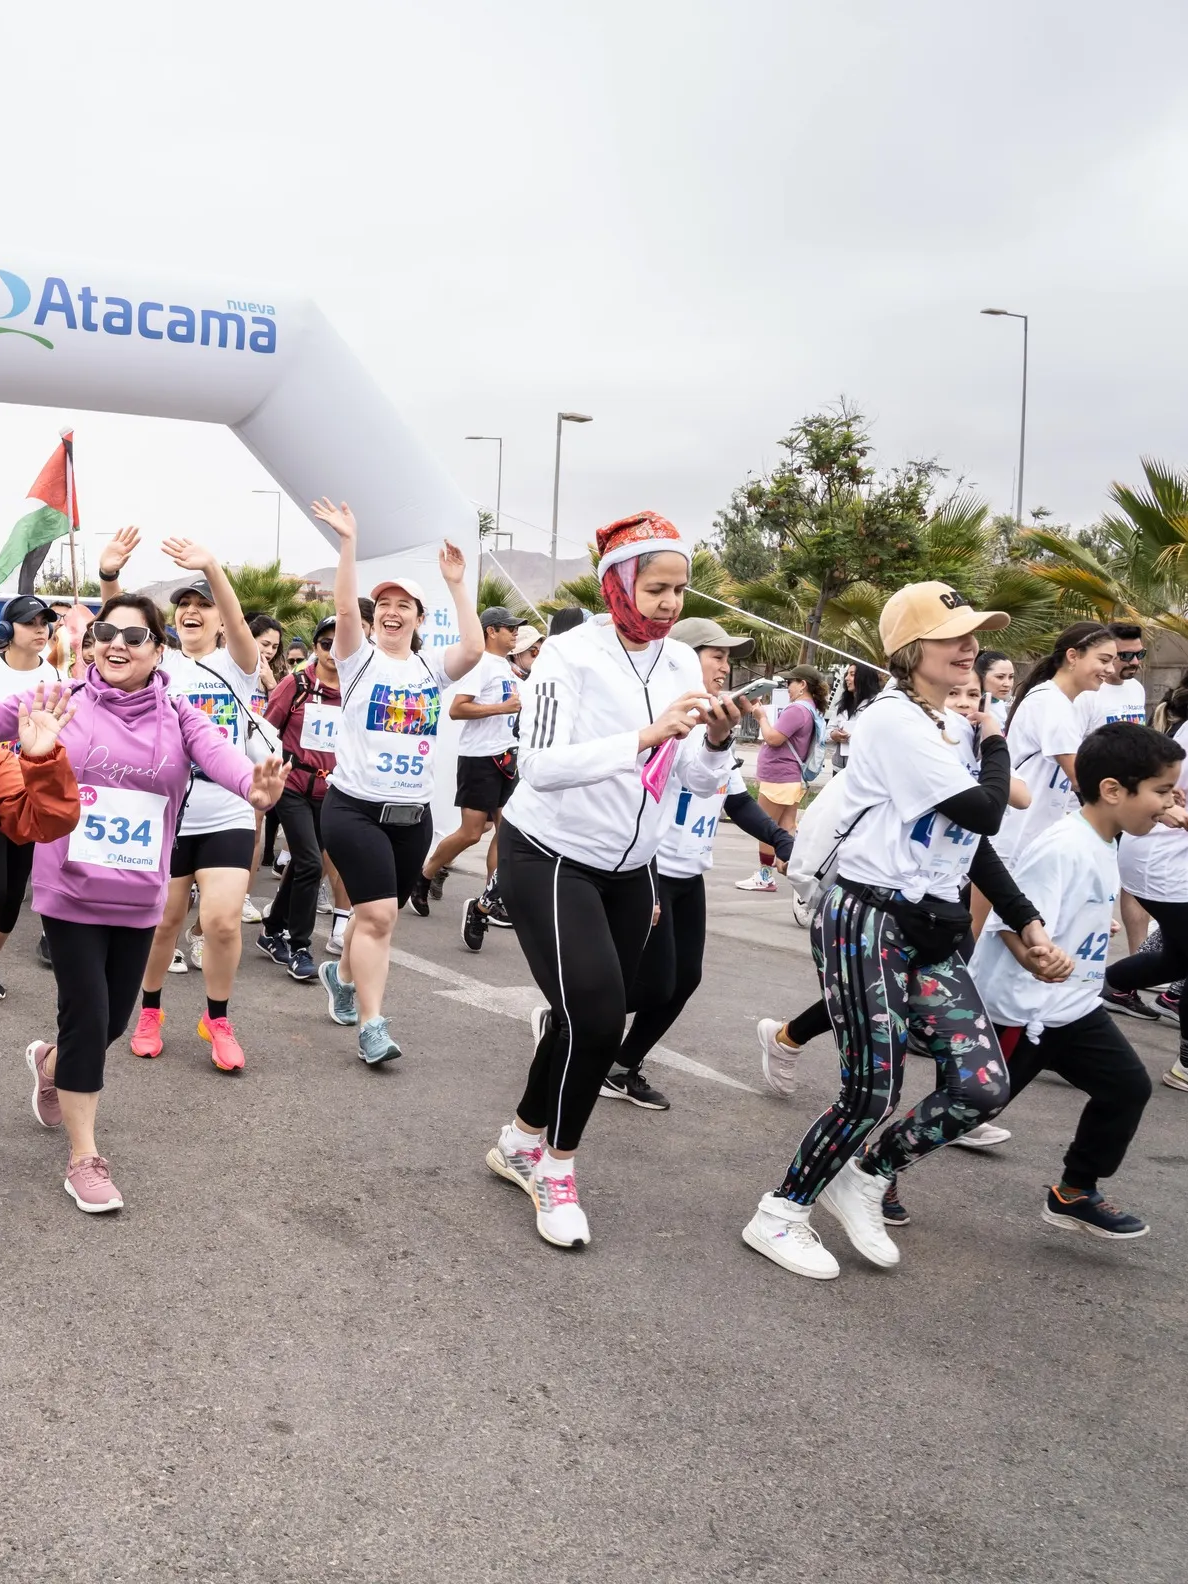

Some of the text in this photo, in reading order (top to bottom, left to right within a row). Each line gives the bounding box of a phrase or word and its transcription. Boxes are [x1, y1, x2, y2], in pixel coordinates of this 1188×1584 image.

[34, 277, 276, 353] Atacama
[227, 300, 275, 315] nueva
[434, 608, 451, 628] ti,
[198, 681, 228, 689] Ataca
[311, 720, 338, 737] 11
[419, 744, 429, 752] 3K
[74, 745, 175, 787] Respect
[376, 752, 424, 776] 355
[399, 781, 423, 789] Atacama
[79, 791, 95, 801] 3K
[83, 814, 152, 847] 534
[691, 815, 717, 838] 41
[116, 854, 153, 866] Atacama
